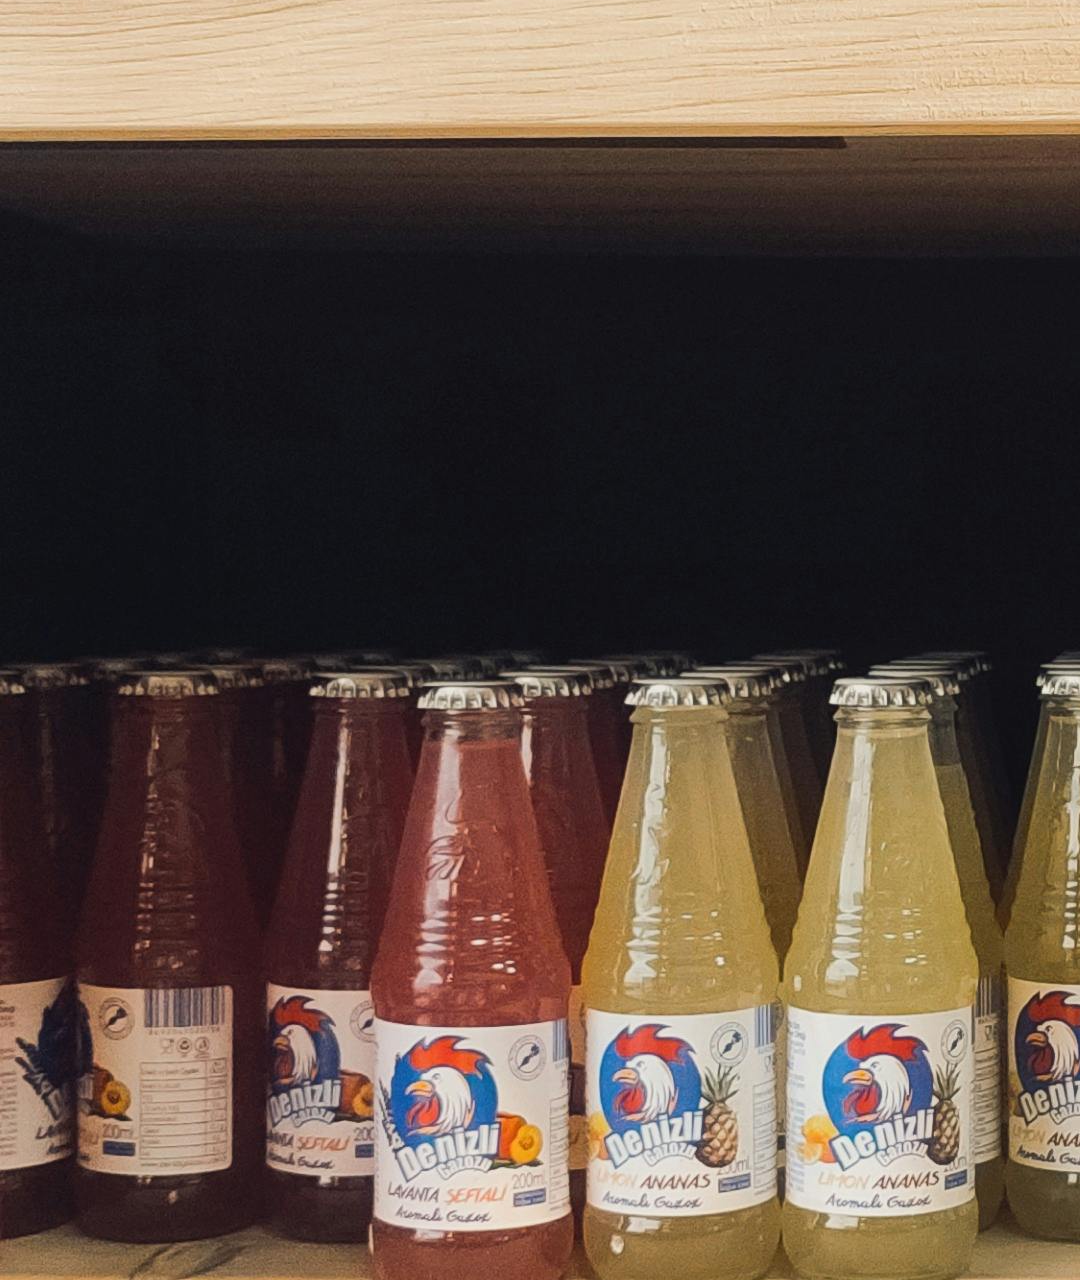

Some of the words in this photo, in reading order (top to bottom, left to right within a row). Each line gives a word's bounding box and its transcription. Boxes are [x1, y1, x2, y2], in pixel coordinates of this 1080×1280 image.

[396, 1123, 501, 1182] Denizli
[605, 1111, 705, 1169] Denizli
[829, 1108, 935, 1171] Denizli
[388, 1182, 440, 1204] LAVANTA
[639, 1174, 711, 1190] ANANAS
[872, 1170, 940, 1190] ANANAS
